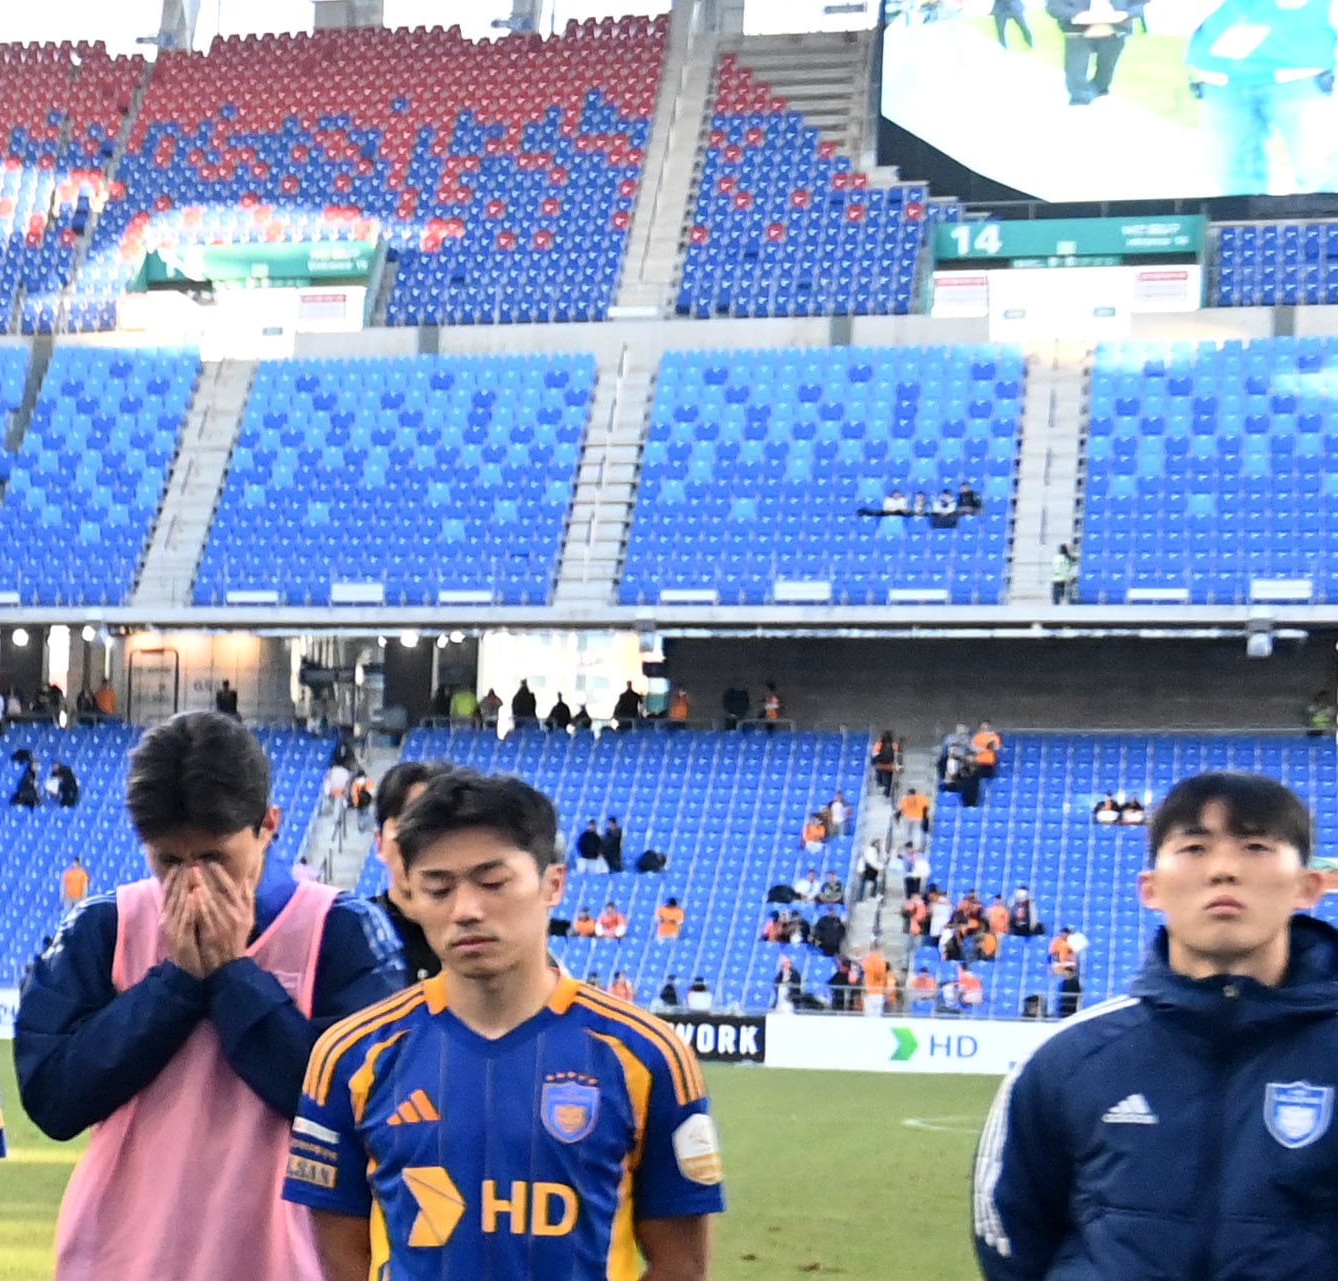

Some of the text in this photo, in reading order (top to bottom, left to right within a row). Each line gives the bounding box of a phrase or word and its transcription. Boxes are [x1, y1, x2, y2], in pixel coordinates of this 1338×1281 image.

[951, 225, 1003, 255] 14
[929, 1034, 979, 1059] HD
[482, 1179, 579, 1237] HD
